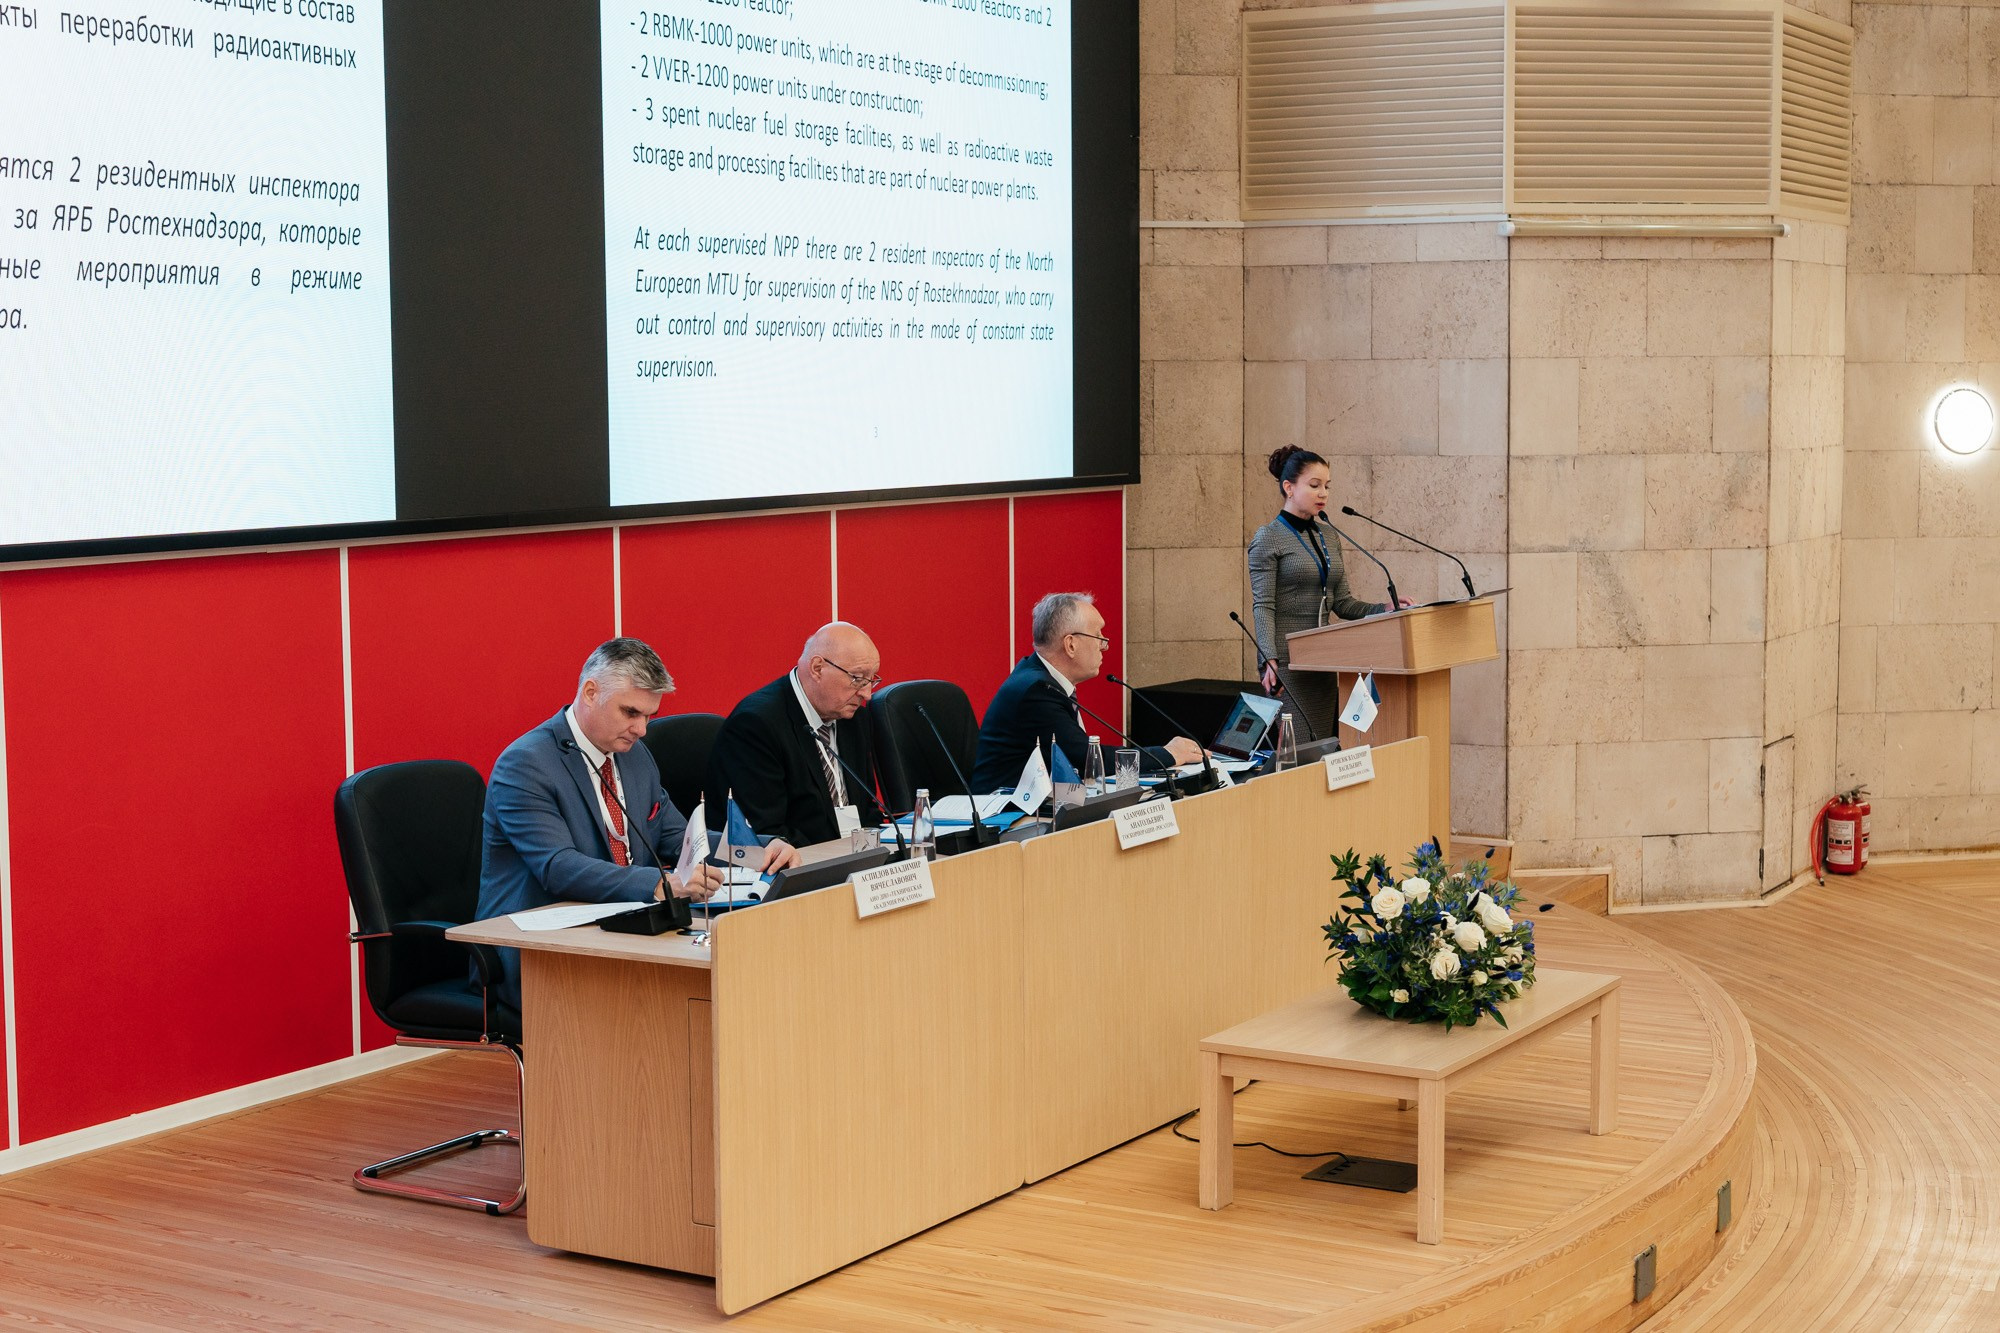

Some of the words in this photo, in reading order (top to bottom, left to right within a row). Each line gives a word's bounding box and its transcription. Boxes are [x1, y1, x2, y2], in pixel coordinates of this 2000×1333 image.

[283, 0, 293, 15] в
[298, 0, 355, 24] состав
[980, 0, 1022, 21] reactors
[1024, 5, 1043, 25] and
[1046, 7, 1052, 27] 2
[60, 12, 194, 49] переработки
[213, 32, 357, 69] радиоактивных
[639, 10, 648, 35] 2
[652, 12, 733, 48] RBMK-1000
[736, 32, 778, 55] power
[781, 36, 815, 65] units,
[818, 40, 854, 67] which
[856, 52, 876, 70] are
[878, 53, 890, 73] at
[892, 51, 911, 76] the
[914, 59, 943, 85] stage
[945, 61, 957, 83] of
[959, 62, 1049, 101] decommissioning;
[640, 54, 649, 79] 2
[652, 55, 729, 89] VVER-1200
[732, 73, 774, 96] power
[777, 76, 808, 100] units
[811, 80, 847, 105] under
[849, 90, 923, 119] construction;
[645, 97, 654, 121] 3
[663, 106, 700, 130] spent
[708, 106, 757, 133] nuclear
[763, 110, 788, 137] fuel
[795, 118, 839, 147] storage
[846, 121, 895, 154] facilities,
[901, 135, 914, 151] as
[919, 132, 942, 154] well
[947, 140, 959, 156] as
[964, 137, 1020, 163] radioactive
[1024, 149, 1053, 167] waste
[69, 156, 81, 183] 2
[96, 159, 236, 194] резидентных
[249, 175, 360, 207] инспектора
[632, 142, 685, 172] storage
[688, 145, 714, 170] and
[717, 153, 786, 182] processing
[788, 154, 839, 182] facilities
[841, 160, 866, 185] that
[868, 169, 887, 187] are
[890, 170, 913, 192] part
[915, 168, 927, 190] of
[929, 171, 969, 194] nuclear
[971, 179, 1004, 199] power
[1006, 177, 1039, 203] plants.
[13, 208, 38, 230] за
[52, 204, 93, 233] ЯРБ
[107, 207, 266, 247] Ростехнадзора,
[279, 223, 361, 251] которые
[633, 225, 651, 250] At
[657, 227, 690, 252] each
[697, 232, 767, 259] supervised
[773, 234, 800, 258] NPP
[805, 235, 838, 260] there
[843, 245, 863, 262] are
[868, 241, 876, 262] 2
[882, 242, 927, 265] resident
[931, 249, 985, 271] inspectors
[989, 247, 1001, 274] of
[1005, 248, 1022, 270] the
[1026, 251, 1054, 272] North
[76, 260, 220, 290] мероприятия
[251, 267, 261, 287] в
[290, 269, 363, 295] режиме
[635, 268, 701, 299] European
[706, 272, 739, 296] MTU
[742, 272, 762, 302] for
[767, 276, 836, 303] supervision
[840, 277, 854, 305] of
[857, 277, 876, 301] the
[880, 279, 904, 302] NRS
[907, 280, 920, 307] of
[923, 281, 1001, 309] Rostekhnadzor,
[1005, 284, 1026, 306] who
[1029, 292, 1054, 311] carry
[636, 313, 661, 335] out
[668, 311, 716, 336] control
[723, 312, 749, 336] and
[755, 315, 826, 342] supervisory
[832, 316, 883, 338] activities
[889, 317, 900, 339] in
[906, 316, 925, 339] the
[930, 317, 961, 340] mode
[966, 318, 978, 344] of
[982, 322, 1026, 340] constant
[1029, 323, 1055, 341] state
[636, 355, 717, 383] supervision.
[1147, 802, 1165, 814] СЕРГЕЙ
[889, 861, 921, 875] ВЛАДИМИР
